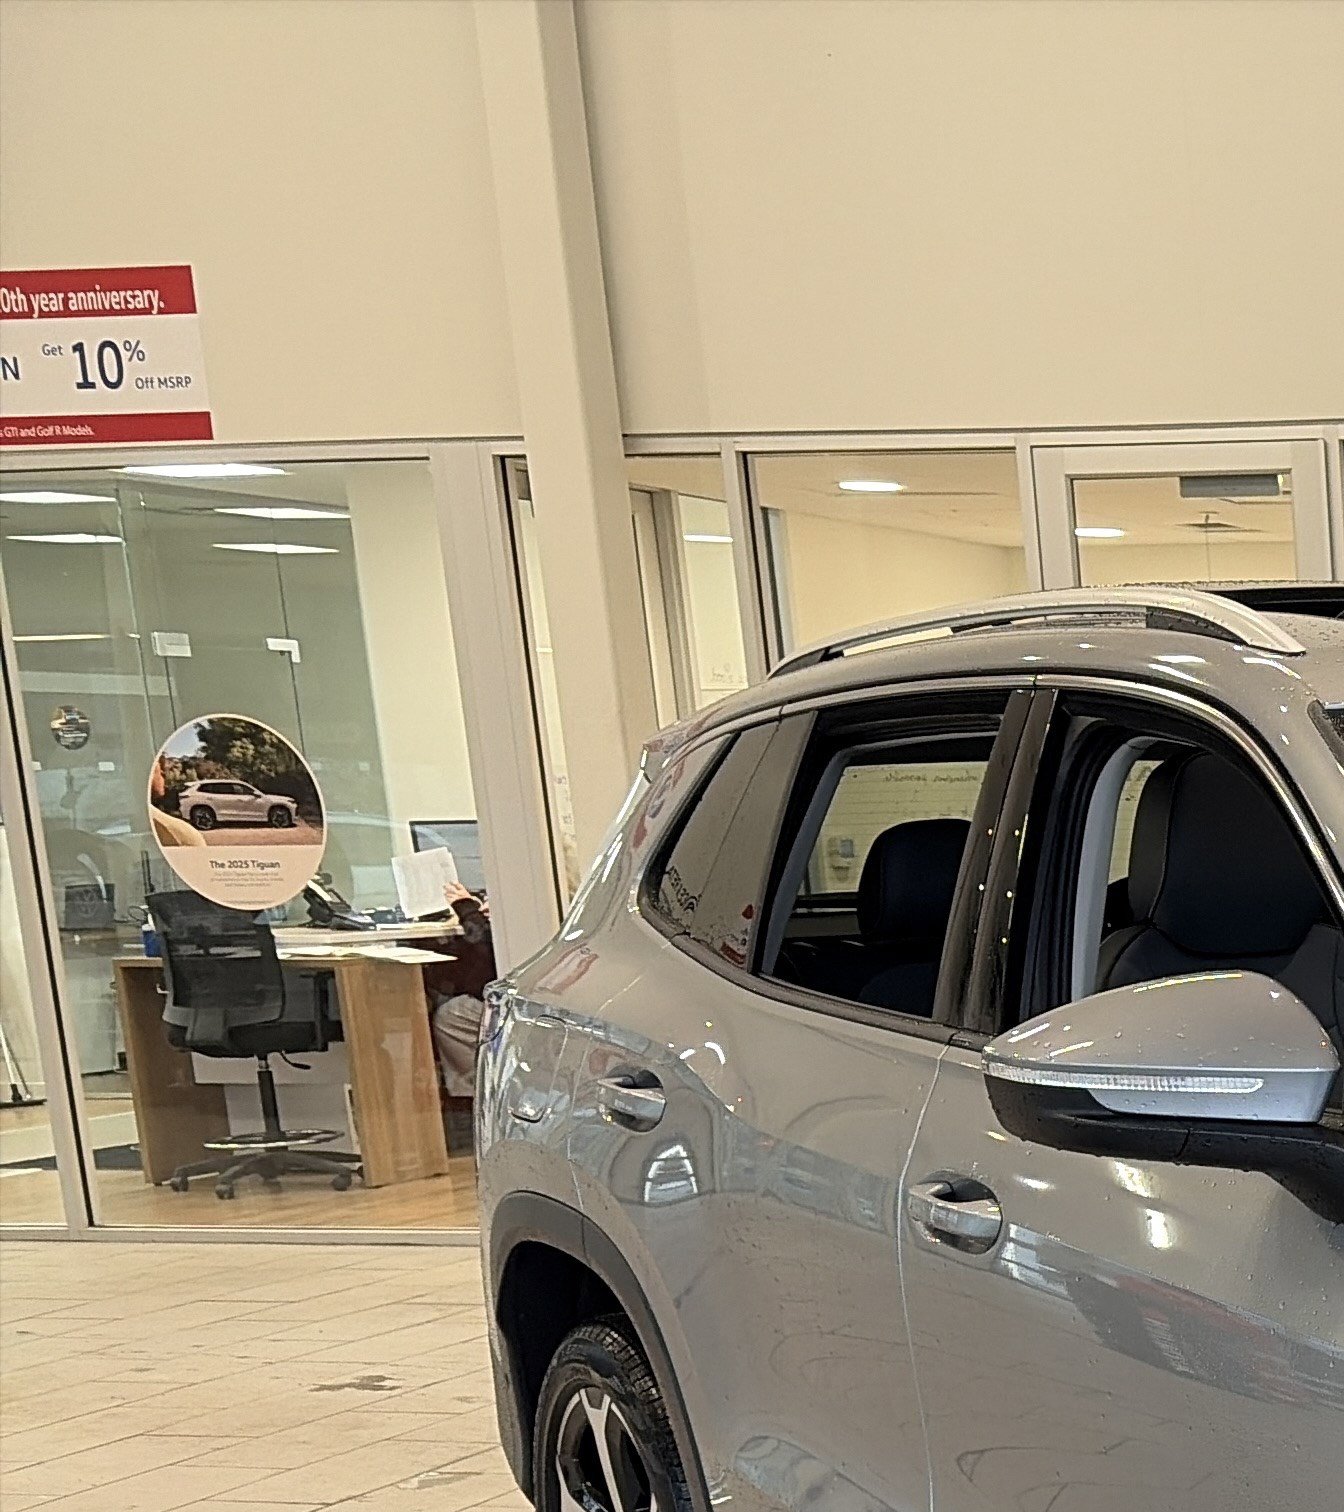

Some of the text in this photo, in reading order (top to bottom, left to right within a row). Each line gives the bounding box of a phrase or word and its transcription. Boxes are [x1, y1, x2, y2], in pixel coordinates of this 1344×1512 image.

[0, 284, 165, 318] 0th year anniversary.
[42, 343, 64, 357] Get
[135, 376, 192, 390] Off MSRP
[209, 859, 281, 870] The 2025 Tiguan
